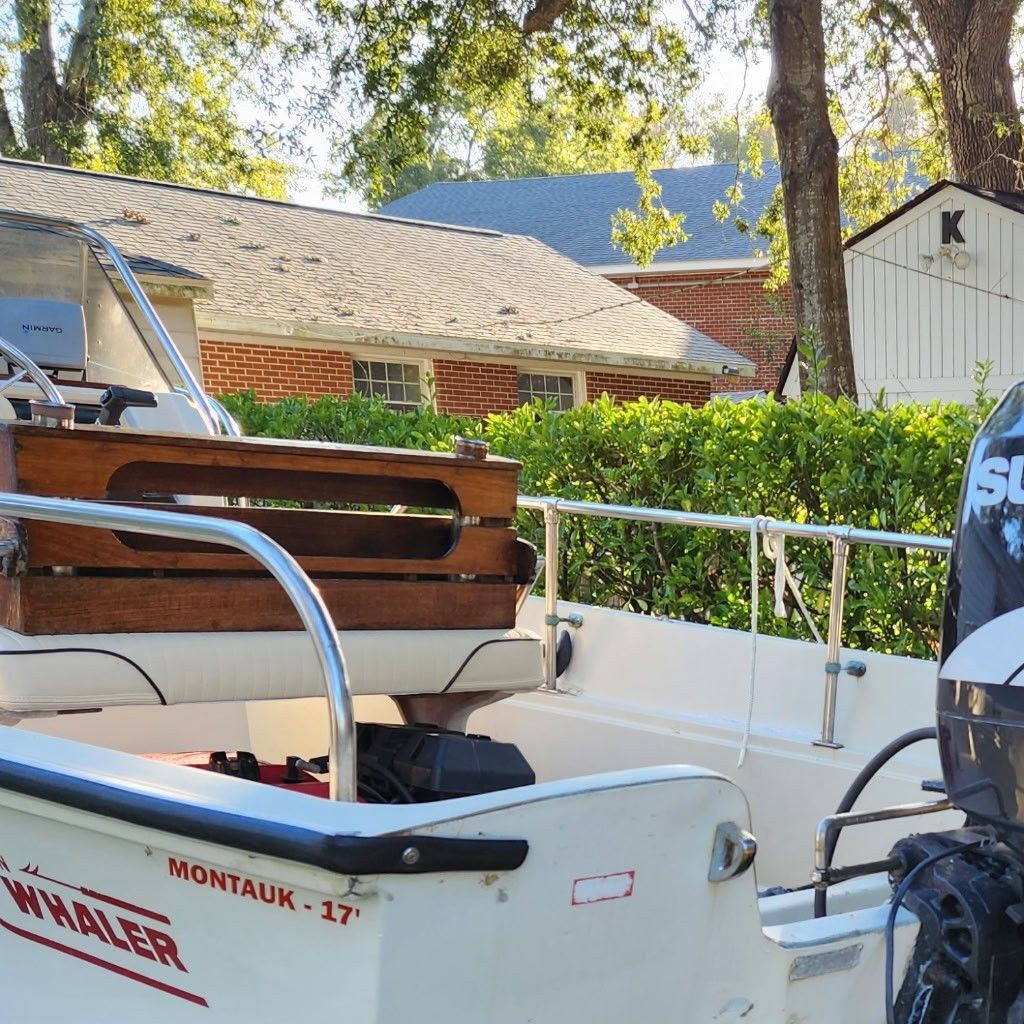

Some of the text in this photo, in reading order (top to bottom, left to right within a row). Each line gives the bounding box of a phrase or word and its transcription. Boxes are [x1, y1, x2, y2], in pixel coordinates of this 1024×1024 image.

[941, 210, 966, 244] K
[22, 324, 63, 334] GARMIN
[168, 857, 296, 911] MONTAUK
[0, 875, 189, 974] WHALER
